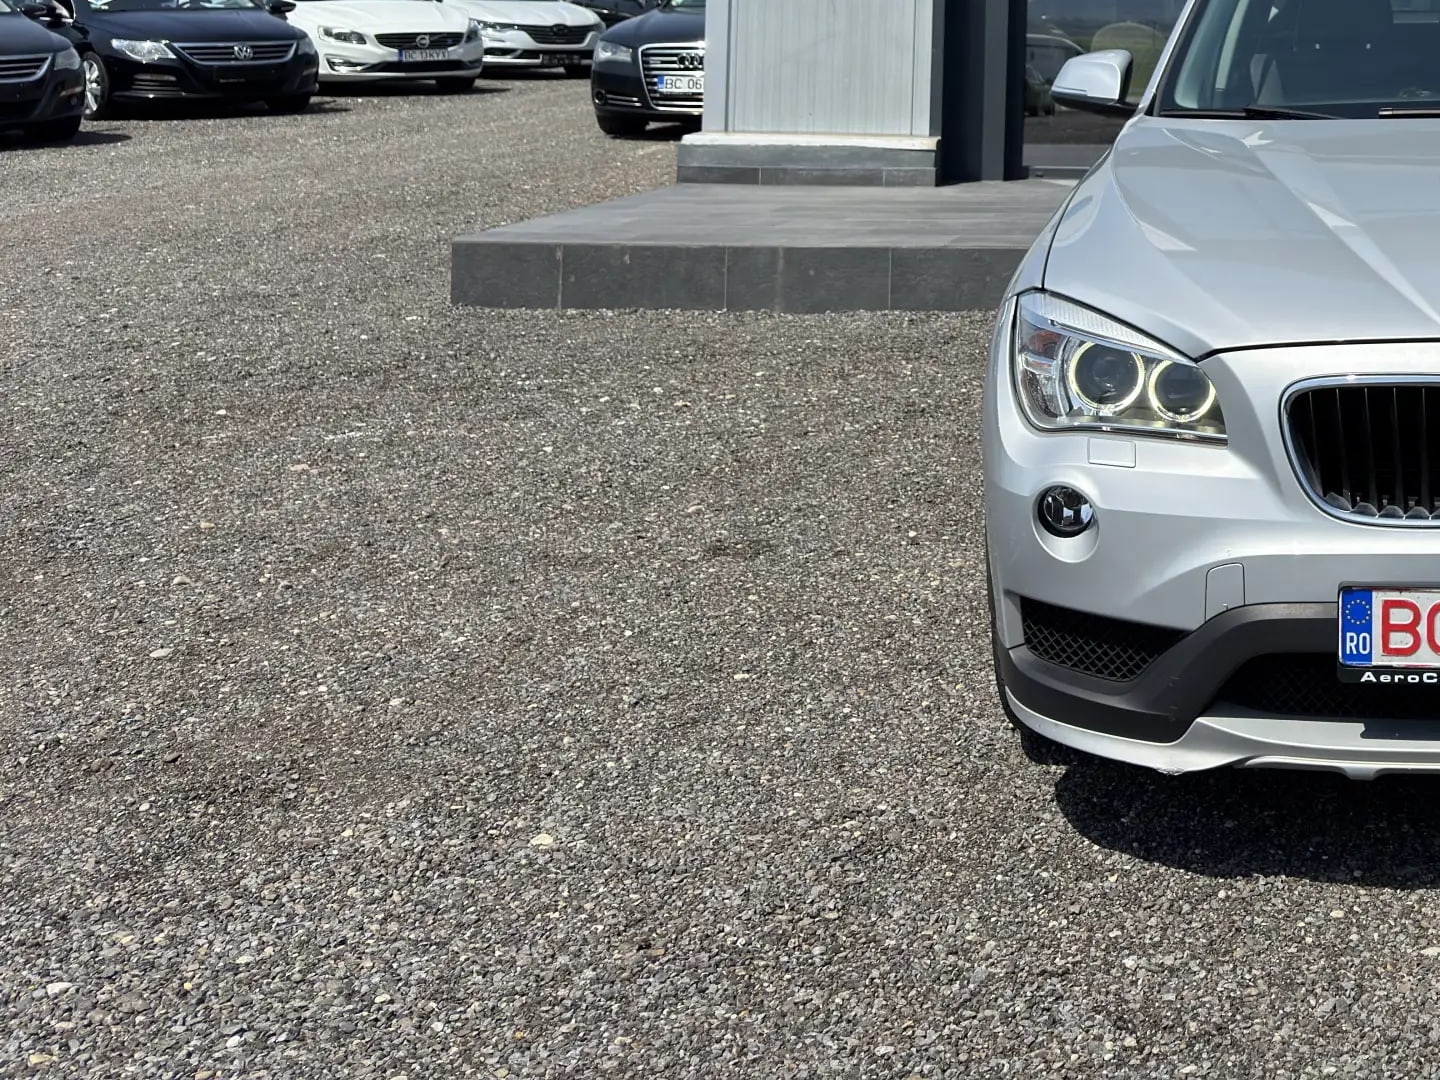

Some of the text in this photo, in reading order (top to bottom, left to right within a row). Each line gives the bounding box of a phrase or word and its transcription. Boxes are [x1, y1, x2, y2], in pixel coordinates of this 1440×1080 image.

[665, 78, 703, 90] BC 06
[1346, 631, 1371, 655] RO
